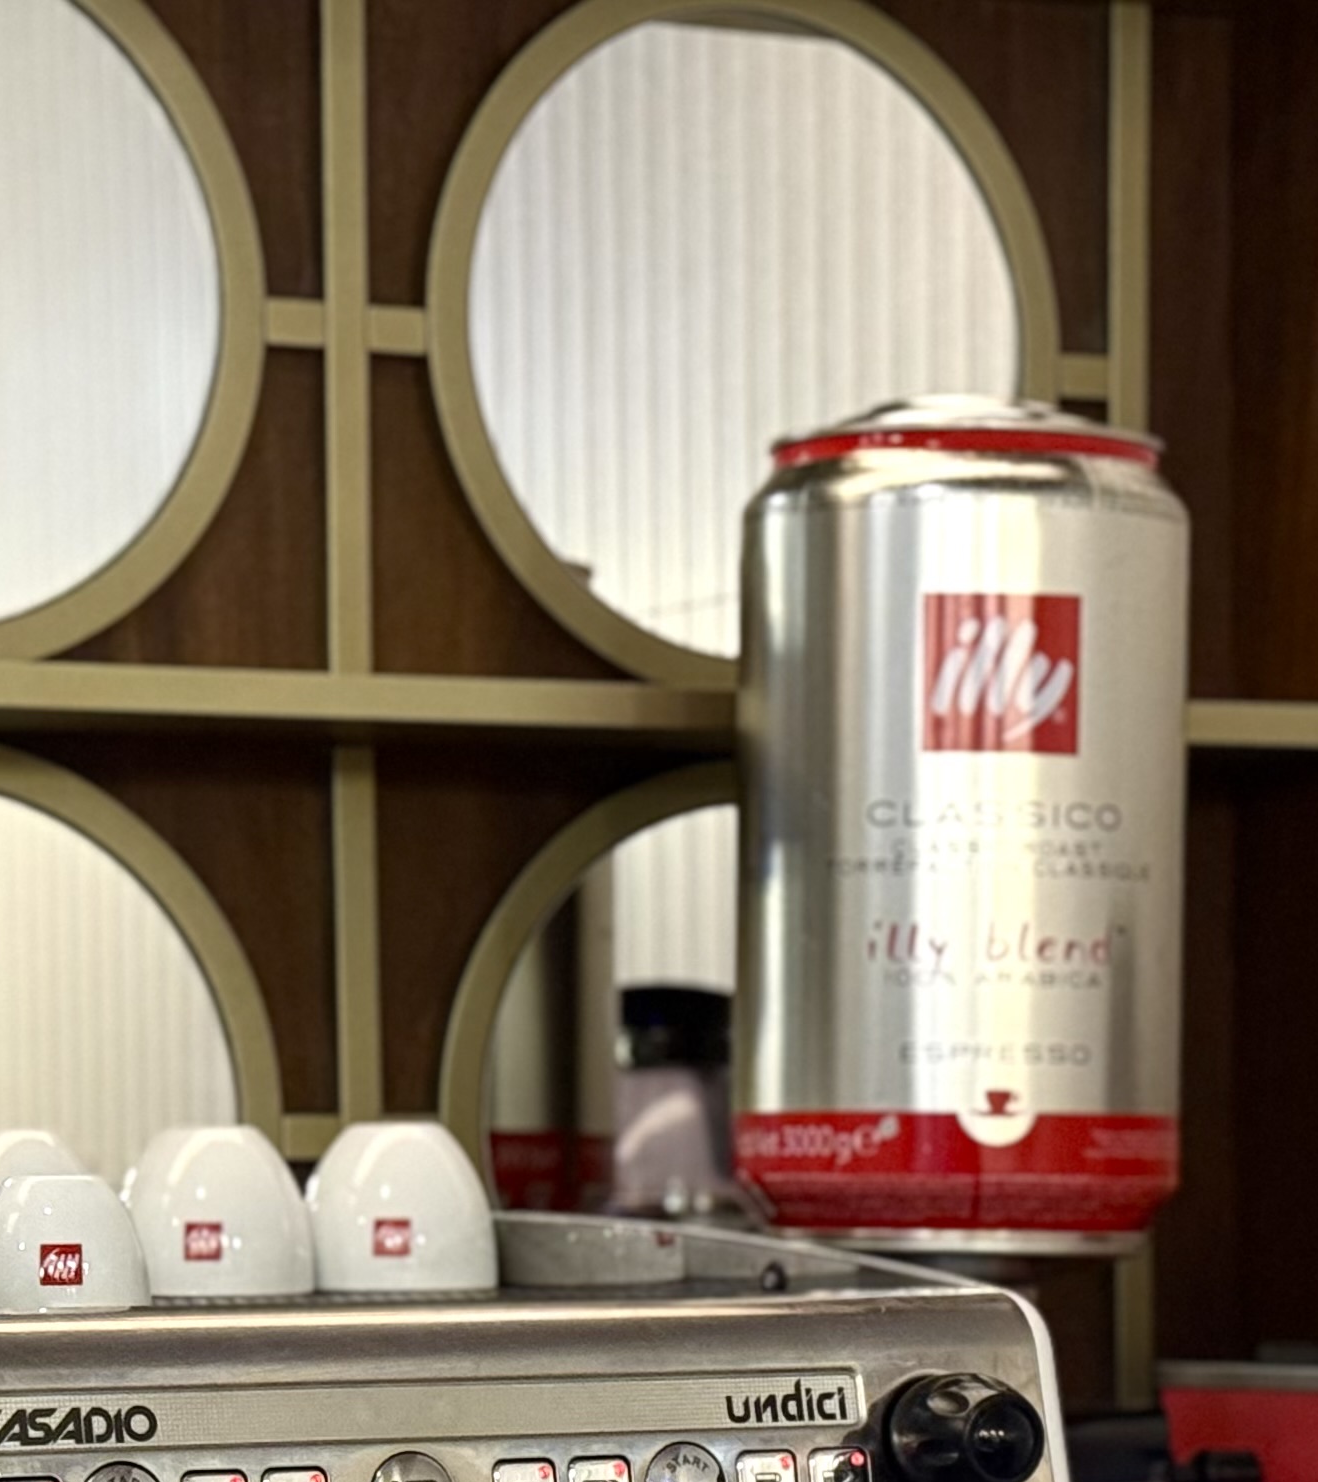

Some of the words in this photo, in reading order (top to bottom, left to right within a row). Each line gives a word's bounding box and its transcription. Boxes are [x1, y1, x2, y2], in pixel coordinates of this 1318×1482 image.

[930, 617, 1073, 742] illy
[865, 798, 1123, 834] CLASSICO
[868, 920, 947, 973] illy
[985, 922, 1113, 965] blend
[899, 1041, 1091, 1066] ESPRESSO
[725, 1378, 848, 1424] undici
[666, 1454, 709, 1474] START
